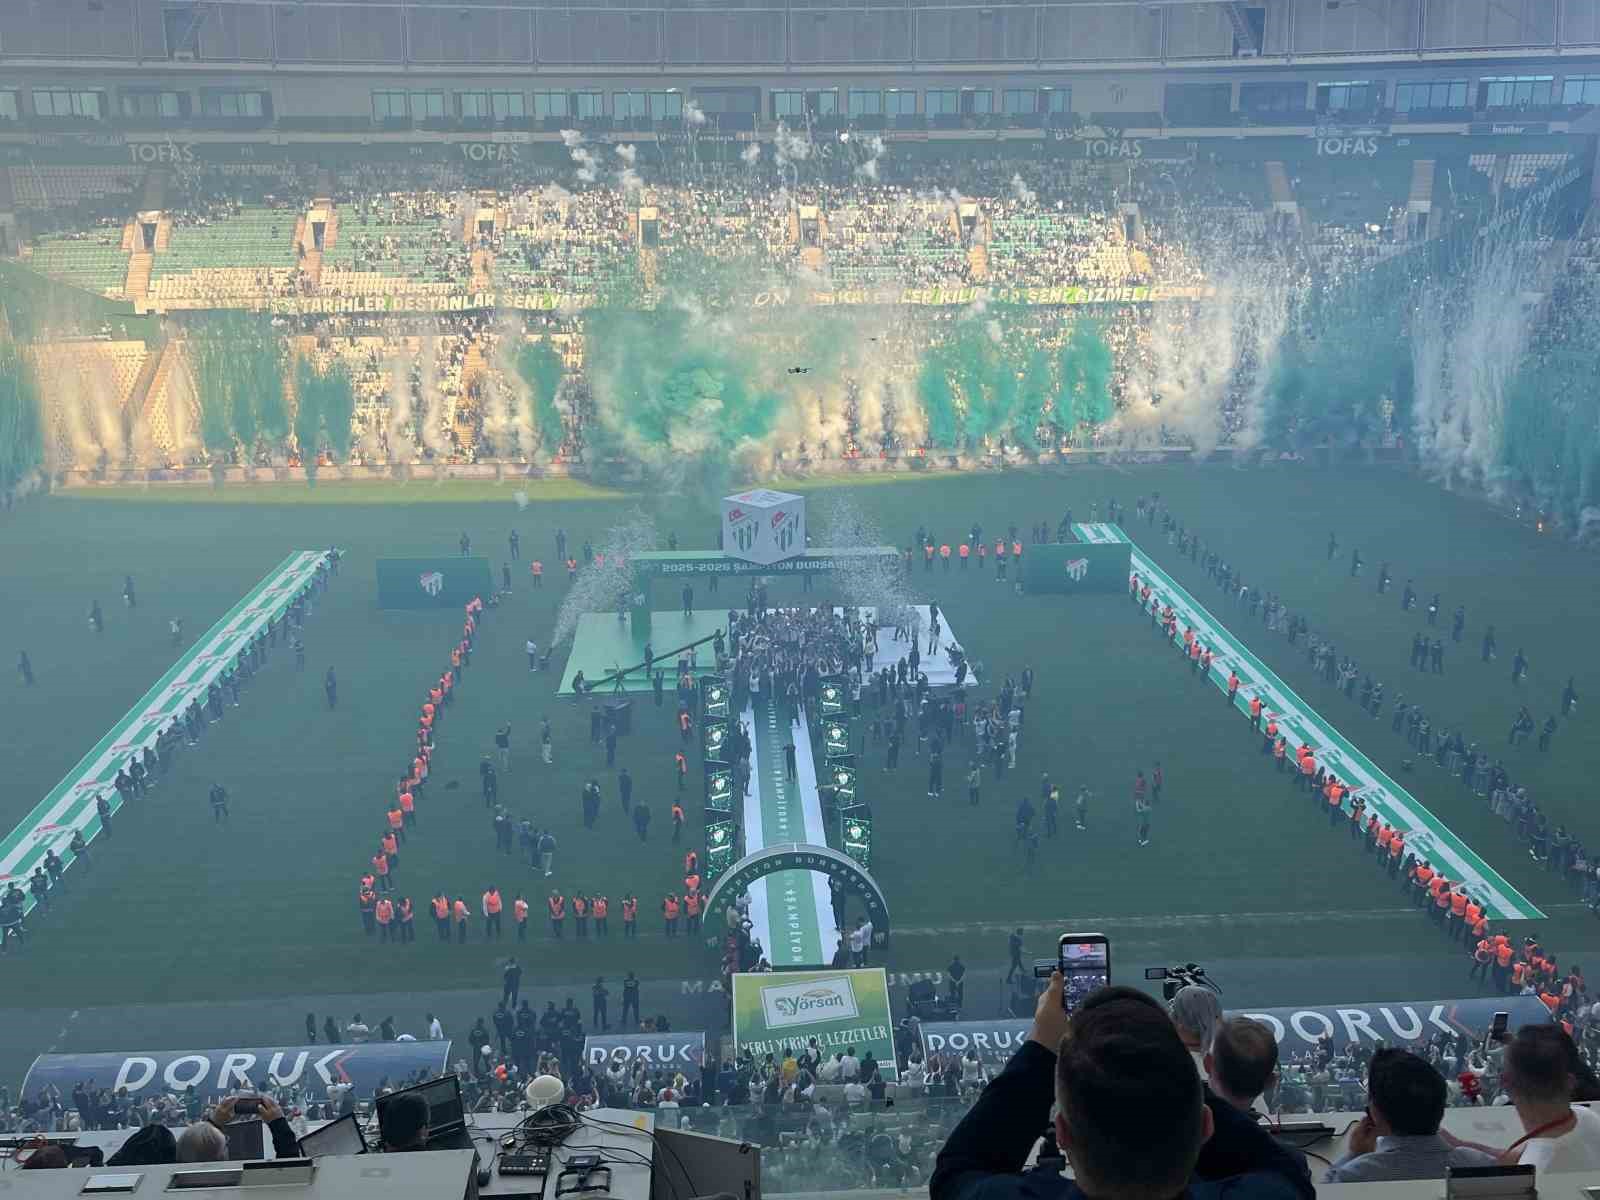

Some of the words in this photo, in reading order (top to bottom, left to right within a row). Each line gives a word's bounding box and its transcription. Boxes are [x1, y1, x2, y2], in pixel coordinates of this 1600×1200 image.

[1316, 137, 1377, 157] TOFAŞ
[786, 993, 844, 1016] Yörsan
[826, 1024, 889, 1047] LEZZETLER
[1243, 1005, 1460, 1045] DORUK
[927, 1030, 1026, 1052] DORUK
[589, 1043, 698, 1065] DORUK
[114, 1049, 350, 1093] DORUK
